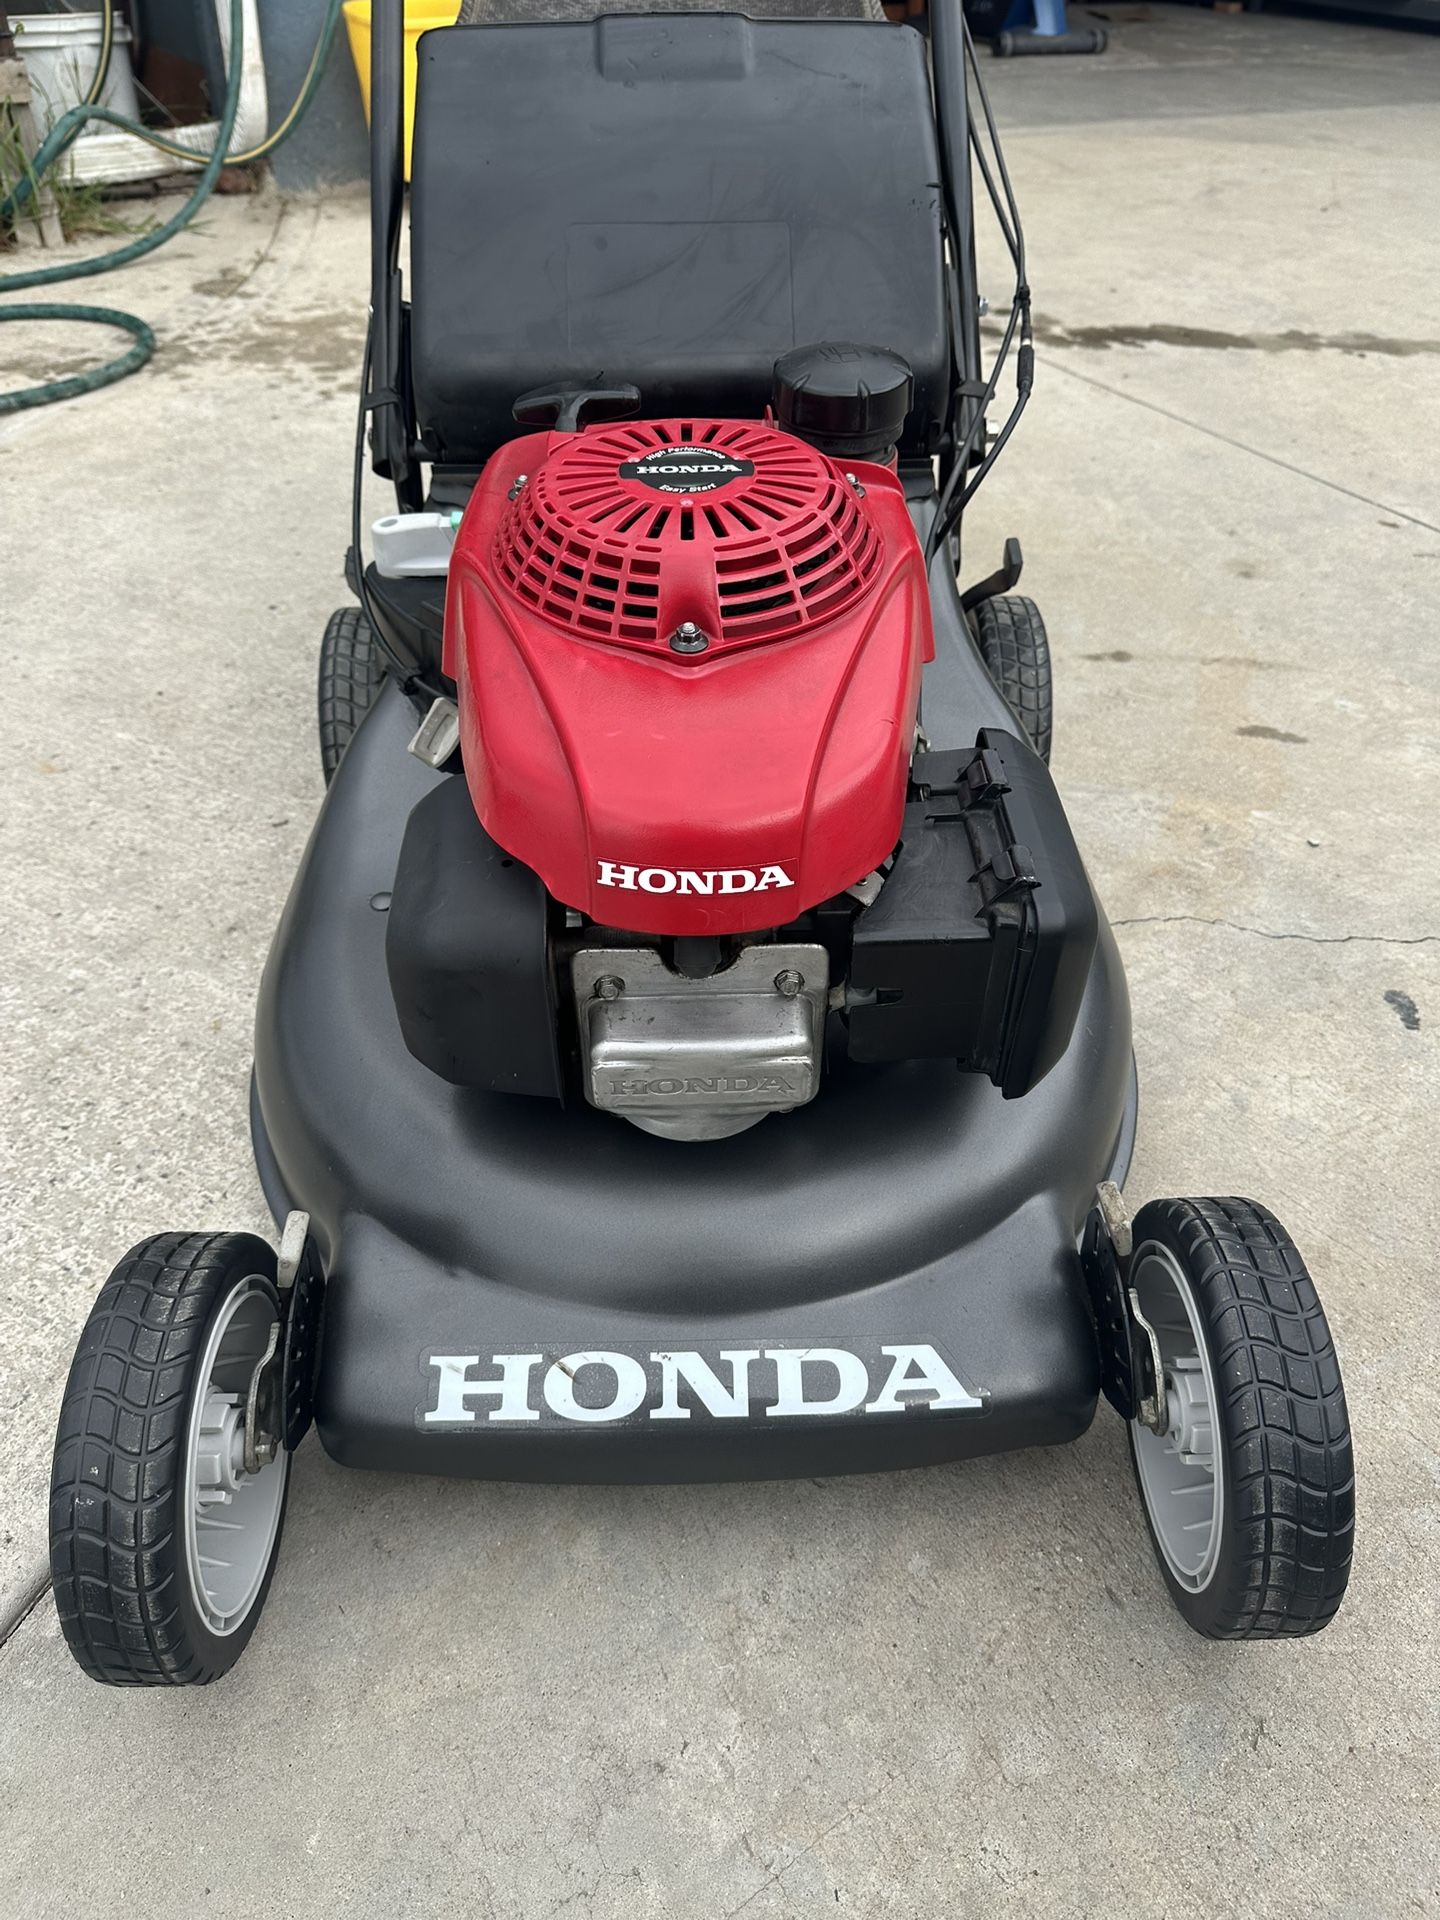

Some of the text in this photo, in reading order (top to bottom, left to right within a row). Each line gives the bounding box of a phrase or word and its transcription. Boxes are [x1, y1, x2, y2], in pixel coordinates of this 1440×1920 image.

[646, 447, 726, 461] High Performance
[636, 464, 742, 474] HONDA
[659, 483, 716, 493] Easy Start
[597, 860, 795, 895] HONDA
[610, 1076, 796, 1097] HONDA
[424, 1344, 983, 1423] HONDA
